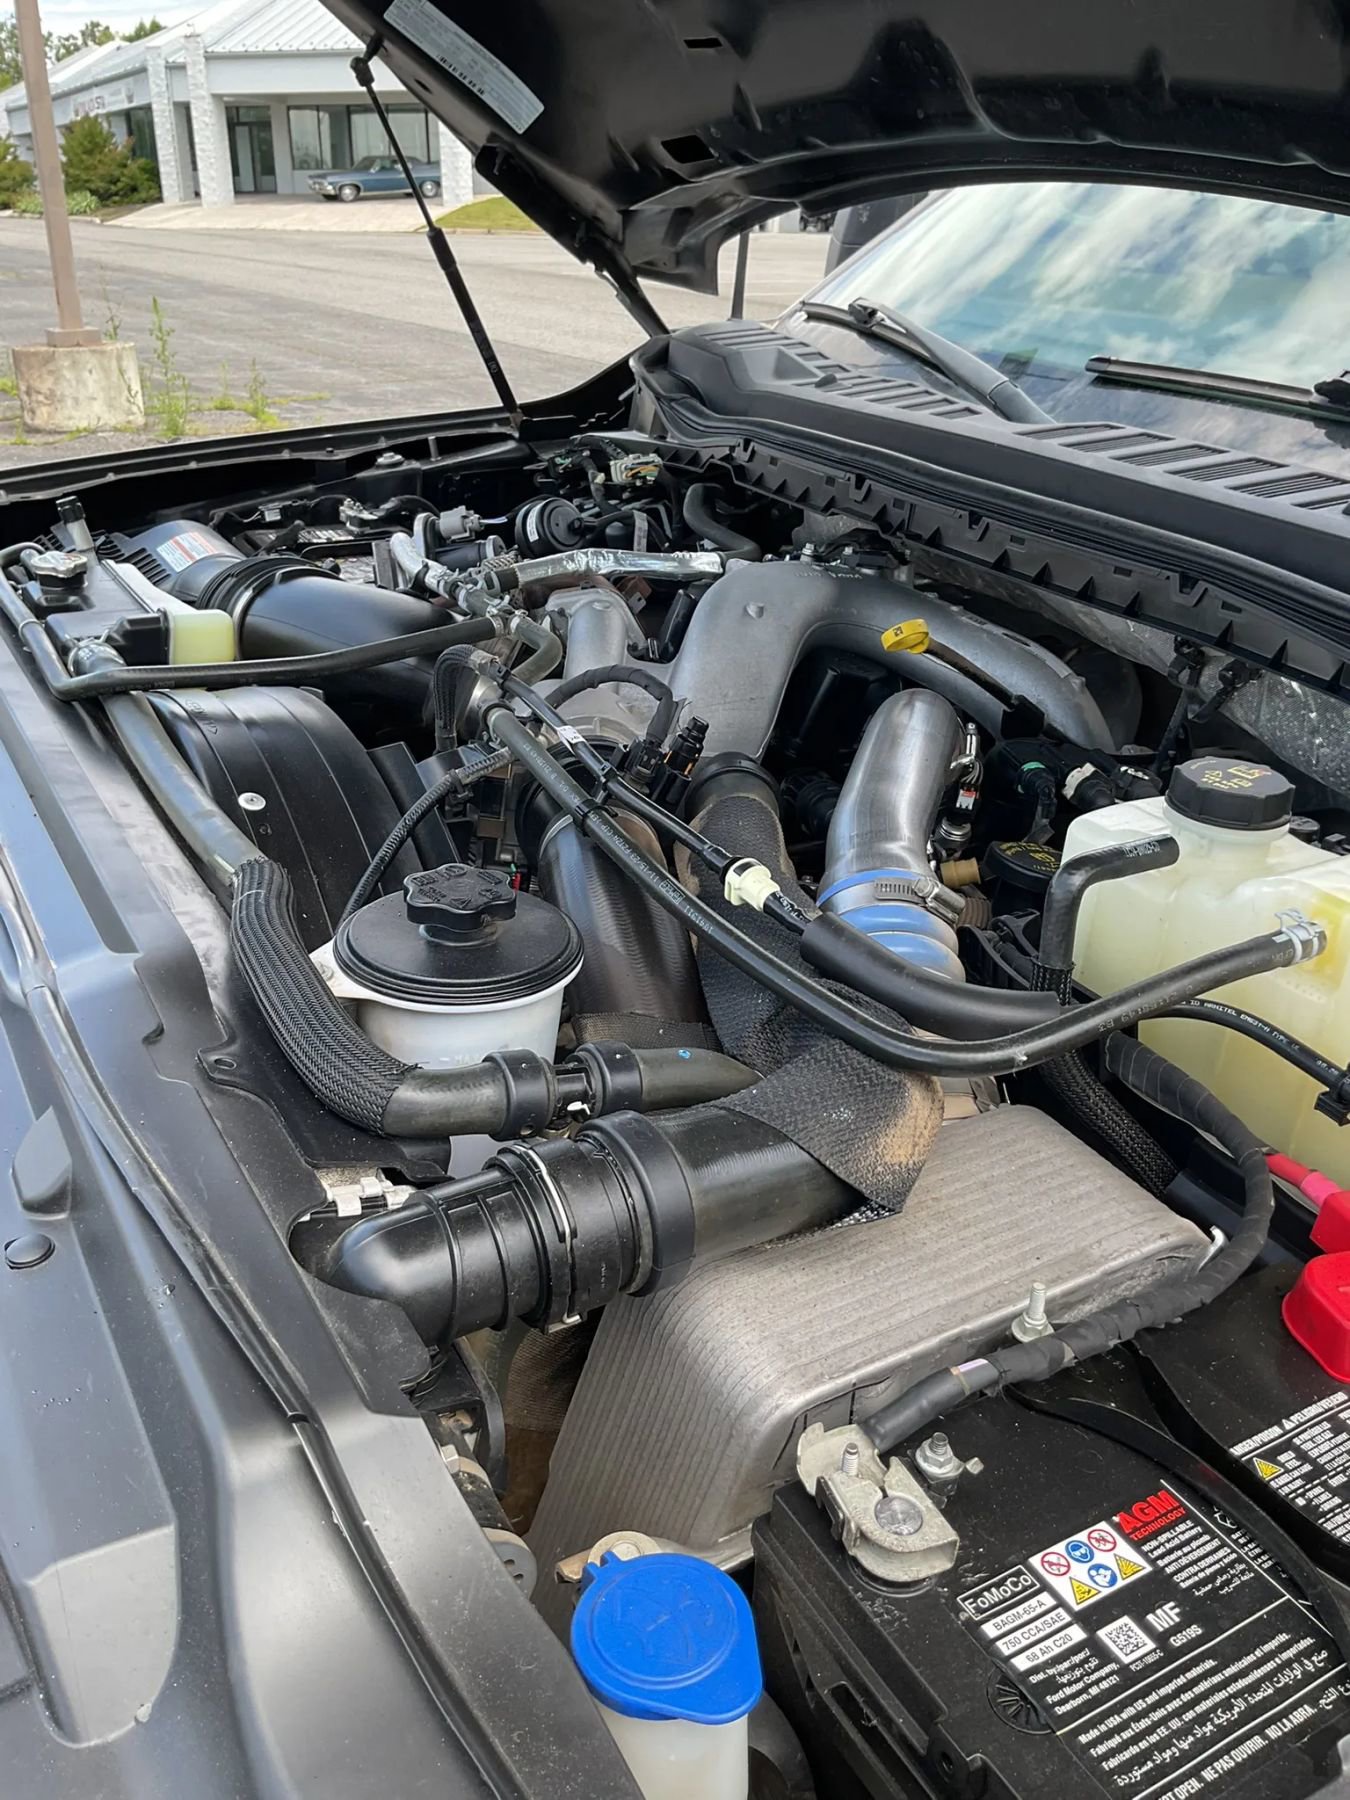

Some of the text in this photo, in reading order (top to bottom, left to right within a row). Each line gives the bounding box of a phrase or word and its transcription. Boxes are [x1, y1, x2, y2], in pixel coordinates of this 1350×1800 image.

[1112, 1490, 1179, 1533] AGM
[1130, 1507, 1185, 1540] TECHNOLOGY
[1141, 1520, 1194, 1552] NON-SPILLABLE
[1148, 1526, 1202, 1559] Lead Acid Battery
[1156, 1550, 1183, 1567] Batterie
[1165, 1562, 1181, 1574] ANTI
[1173, 1547, 1231, 1582] CONTRA DERRAMES
[964, 1575, 1032, 1613] FoMoCo
[992, 1600, 1046, 1631] BAGM-65-A
[1002, 1612, 1066, 1650] 750 CCA/SAE
[1146, 1601, 1180, 1632] MF
[1026, 1633, 1073, 1662] 68 Ah C20
[1170, 1625, 1202, 1646] G519S
[1273, 1662, 1303, 1687] الولايات
[1301, 1657, 1315, 1672] في
[1311, 1650, 1328, 1667] صنع
[1029, 1672, 1048, 1683] Dist.
[1046, 1662, 1120, 1704] Ford Motor Company,
[1138, 1740, 1149, 1749] en
[1146, 1733, 1160, 1744] los
[1156, 1726, 1171, 1737] EE.
[1168, 1718, 1184, 1730] UU.
[1182, 1710, 1196, 1721] con
[1194, 1690, 1229, 1714] materiales
[1278, 1637, 1316, 1661] importados.
[1244, 1681, 1274, 1704] المتحدة
[1054, 1675, 1119, 1715] Dearborn, MI 48121
[1078, 1659, 1218, 1744] Made in USA with US and imported materials.
[1090, 1734, 1122, 1757] Fabriqué
[1120, 1728, 1135, 1739] aux
[1131, 1708, 1168, 1732] États-Unis
[1165, 1698, 1183, 1712] avec
[1180, 1691, 1195, 1702] des
[1192, 1673, 1225, 1695] matériaux
[1222, 1653, 1257, 1677] américains
[1254, 1648, 1264, 1657] et
[1174, 1777, 1204, 1800] OPEN.
[1201, 1766, 1219, 1782] NE
[1213, 1755, 1235, 1773] PAS
[1230, 1735, 1268, 1762] OUVRIR.
[1265, 1725, 1282, 1739] NO
[1277, 1718, 1294, 1732] LA
[1288, 1704, 1317, 1725] ABRA.
